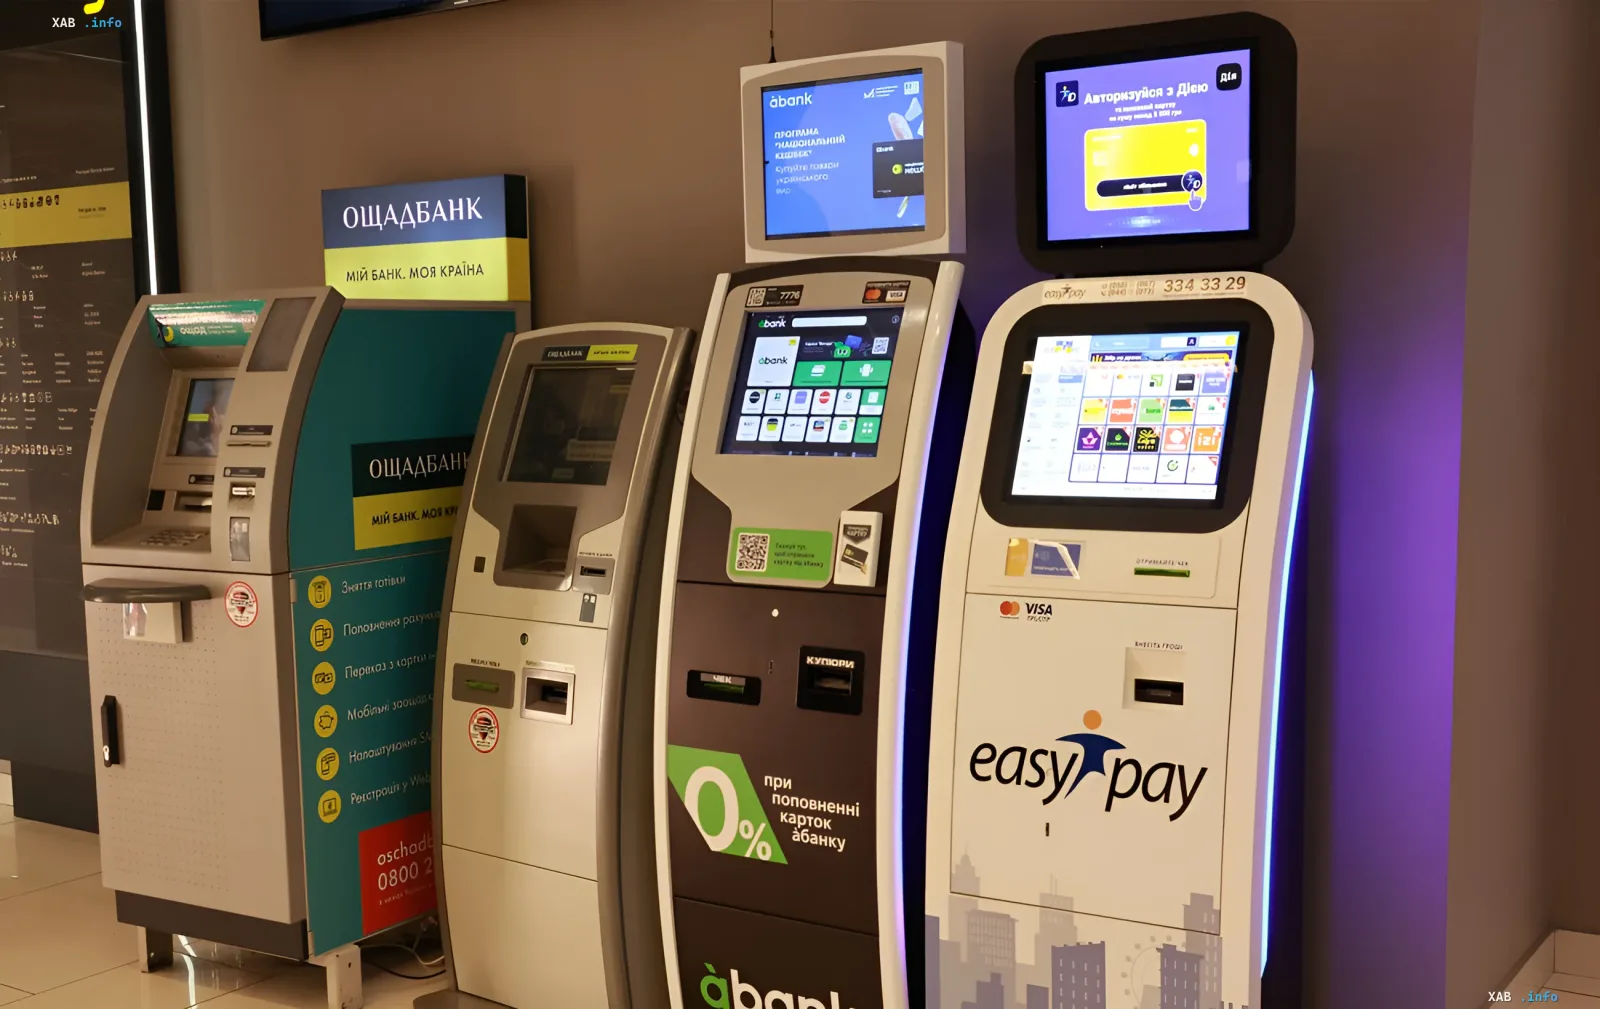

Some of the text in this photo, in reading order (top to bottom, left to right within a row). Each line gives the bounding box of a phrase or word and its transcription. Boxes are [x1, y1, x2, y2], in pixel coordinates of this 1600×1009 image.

[1083, 82, 1209, 105] Авторизуйся з Дією
[774, 128, 819, 139] ПРОГРАМА
[342, 196, 483, 231] ОЩАДБАНК
[346, 261, 484, 282] МІЙ БАНК. МОЯ КРАЇНА
[1163, 276, 1246, 293] 334 33 29
[371, 511, 390, 526] МІЙ
[421, 506, 443, 519] МОЯ
[341, 576, 406, 594] Зняття готівки
[1025, 603, 1053, 615] VISA
[343, 618, 400, 636] Поповнення
[345, 662, 387, 679] Переказ
[806, 656, 855, 669] КУПЮРИ
[712, 675, 733, 684] ЧЕК
[347, 700, 390, 720] Мобільні
[764, 775, 792, 791] при
[969, 742, 1208, 822] easy pay
[772, 793, 860, 817] поповненні
[780, 811, 832, 830] карток
[378, 862, 419, 890] 0800
